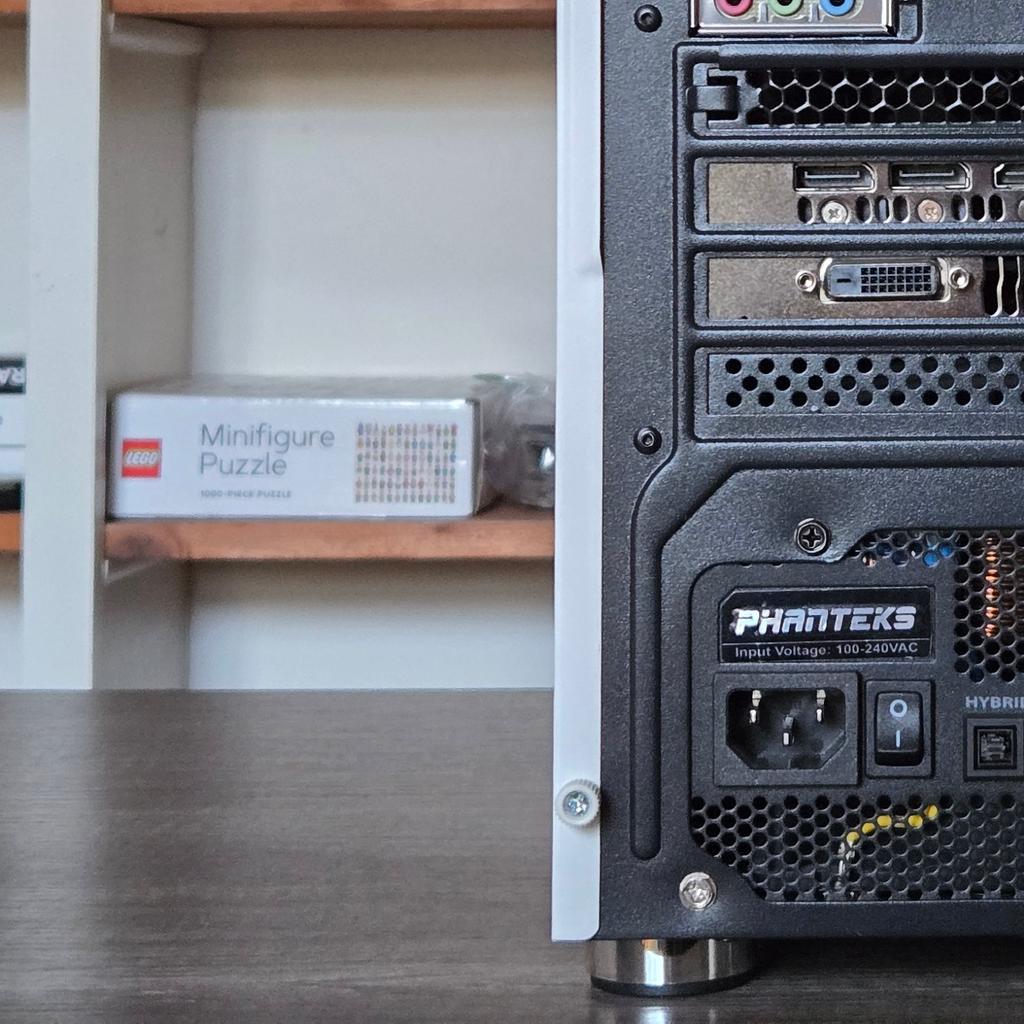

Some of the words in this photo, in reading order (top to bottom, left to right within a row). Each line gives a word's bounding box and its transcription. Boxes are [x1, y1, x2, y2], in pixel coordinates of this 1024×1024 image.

[199, 422, 335, 454] Minifigure
[125, 449, 160, 465] LEGO
[200, 451, 288, 476] Puzzle
[257, 489, 292, 499] PUZZLE
[734, 606, 917, 636] PHANTEKS
[735, 647, 771, 658] Input
[775, 645, 831, 658] Voltage:
[836, 642, 919, 655] 100-240VAC
